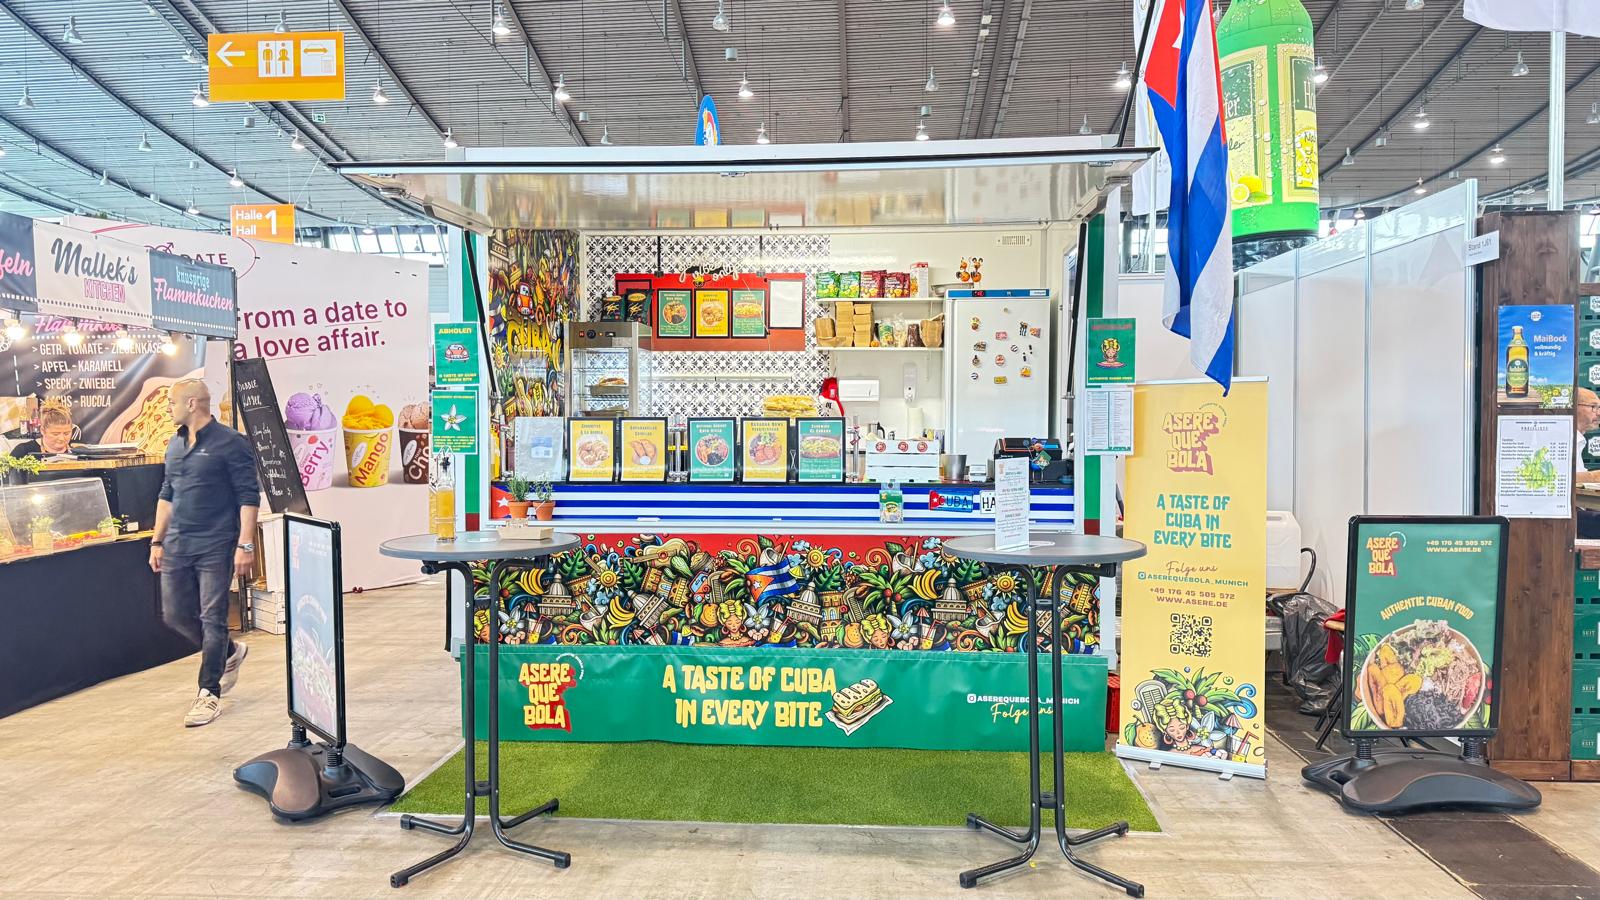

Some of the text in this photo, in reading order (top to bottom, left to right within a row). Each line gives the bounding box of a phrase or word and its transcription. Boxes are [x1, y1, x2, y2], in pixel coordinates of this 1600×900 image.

[235, 210, 262, 221] Halle
[265, 209, 278, 235] 1
[235, 225, 256, 236] Hall
[51, 237, 138, 286] Mallek's
[175, 265, 210, 292] knusprige
[84, 278, 125, 303] KITCHEN
[153, 277, 233, 310] Flammkuchen
[243, 299, 407, 329] rom a date to
[40, 343, 65, 355] GETR.
[233, 326, 386, 359] a love affair.
[42, 361, 71, 373] APFEL
[78, 360, 124, 372] KARAMELL
[45, 378, 71, 390] SPECK
[79, 378, 116, 390] ZWIEBEL
[80, 395, 111, 407] RUCOLA
[1162, 412, 1217, 433] ASERE
[1172, 430, 1203, 450] QUE
[354, 432, 389, 486] Mango
[1166, 450, 1211, 474] BOLA
[939, 495, 968, 509] CUBA
[1156, 494, 1231, 511] A TASTE OF
[1165, 513, 1220, 531] CUBA IN
[1154, 530, 1232, 548] EVERY BITE
[1366, 537, 1399, 550] ASERE
[1372, 549, 1391, 562] QUE
[1165, 560, 1197, 576] Folge
[1368, 562, 1394, 576] BOLA
[1156, 595, 1228, 608] WWW.ASERE.DE
[1219, 592, 1235, 600] 572
[1380, 596, 1474, 621] AUTHENTIC CUBAN FOOD
[518, 662, 571, 686] ASERE
[662, 664, 836, 697] A TASTE OF CUBA
[528, 683, 560, 706] QUE
[523, 704, 566, 729] BOLA
[675, 698, 823, 730] IN EVERY BITE
[991, 702, 1029, 724] Folge
